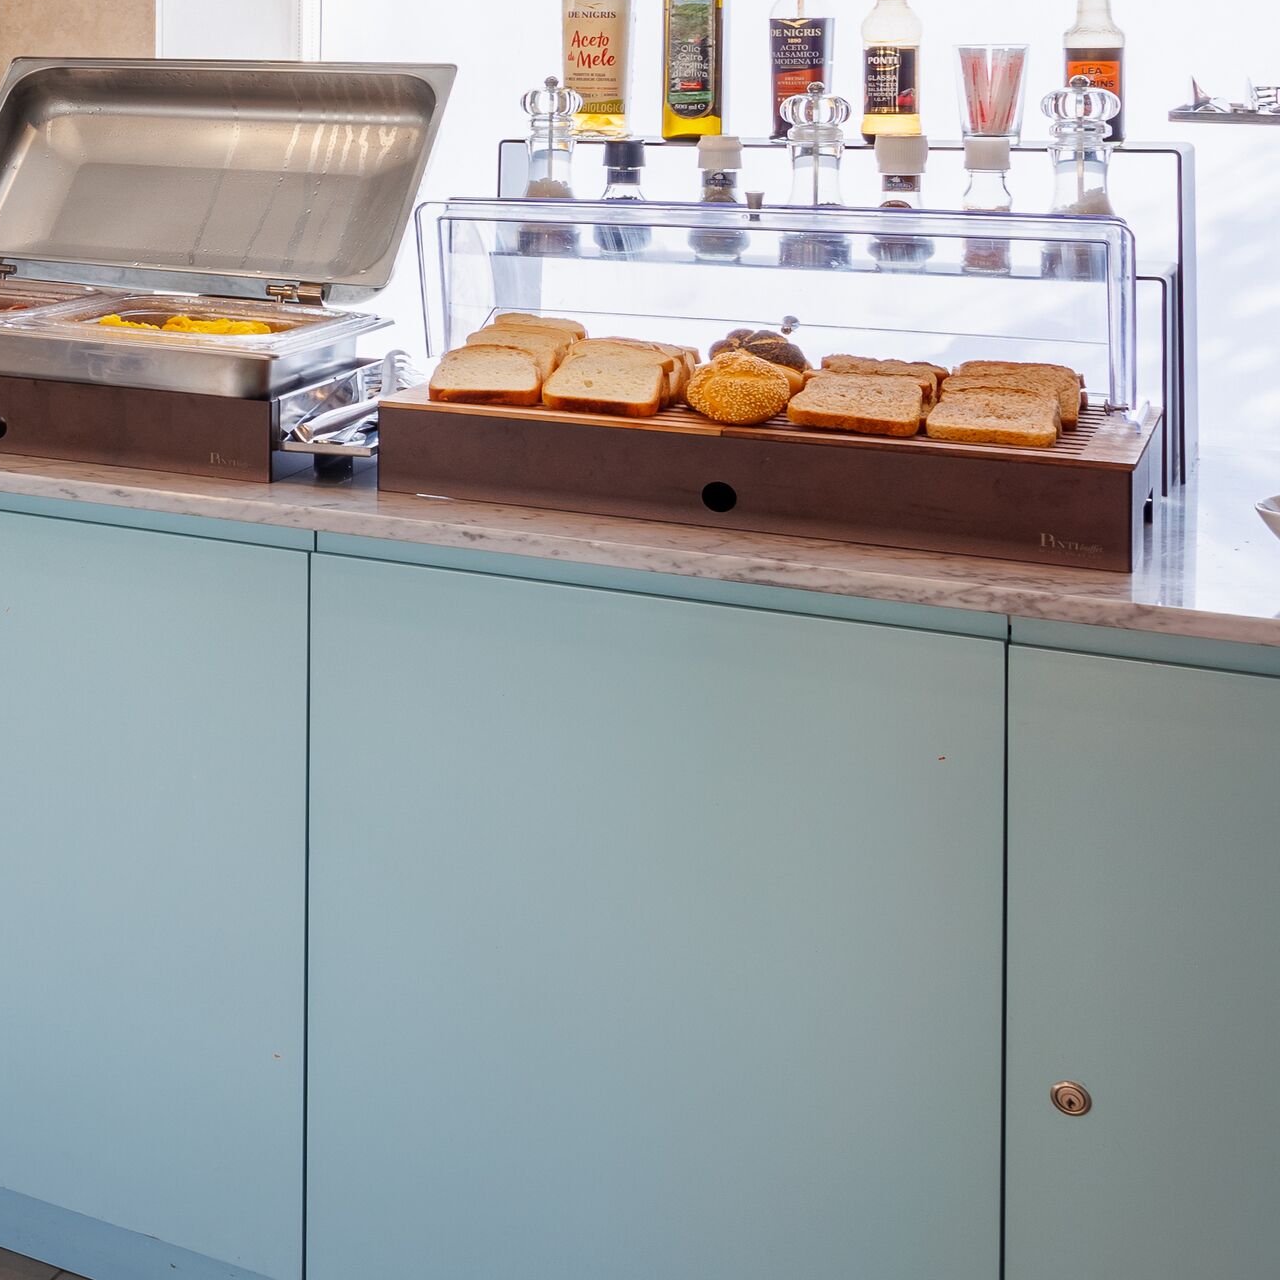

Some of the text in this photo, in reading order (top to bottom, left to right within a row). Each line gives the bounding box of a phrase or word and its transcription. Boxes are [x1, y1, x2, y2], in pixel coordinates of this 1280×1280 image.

[568, 11, 617, 19] DE NIGRIS
[783, 28, 822, 37] NIGRIS
[571, 30, 610, 48] Aceto
[576, 48, 617, 69] Mele
[867, 56, 899, 65] PONTI
